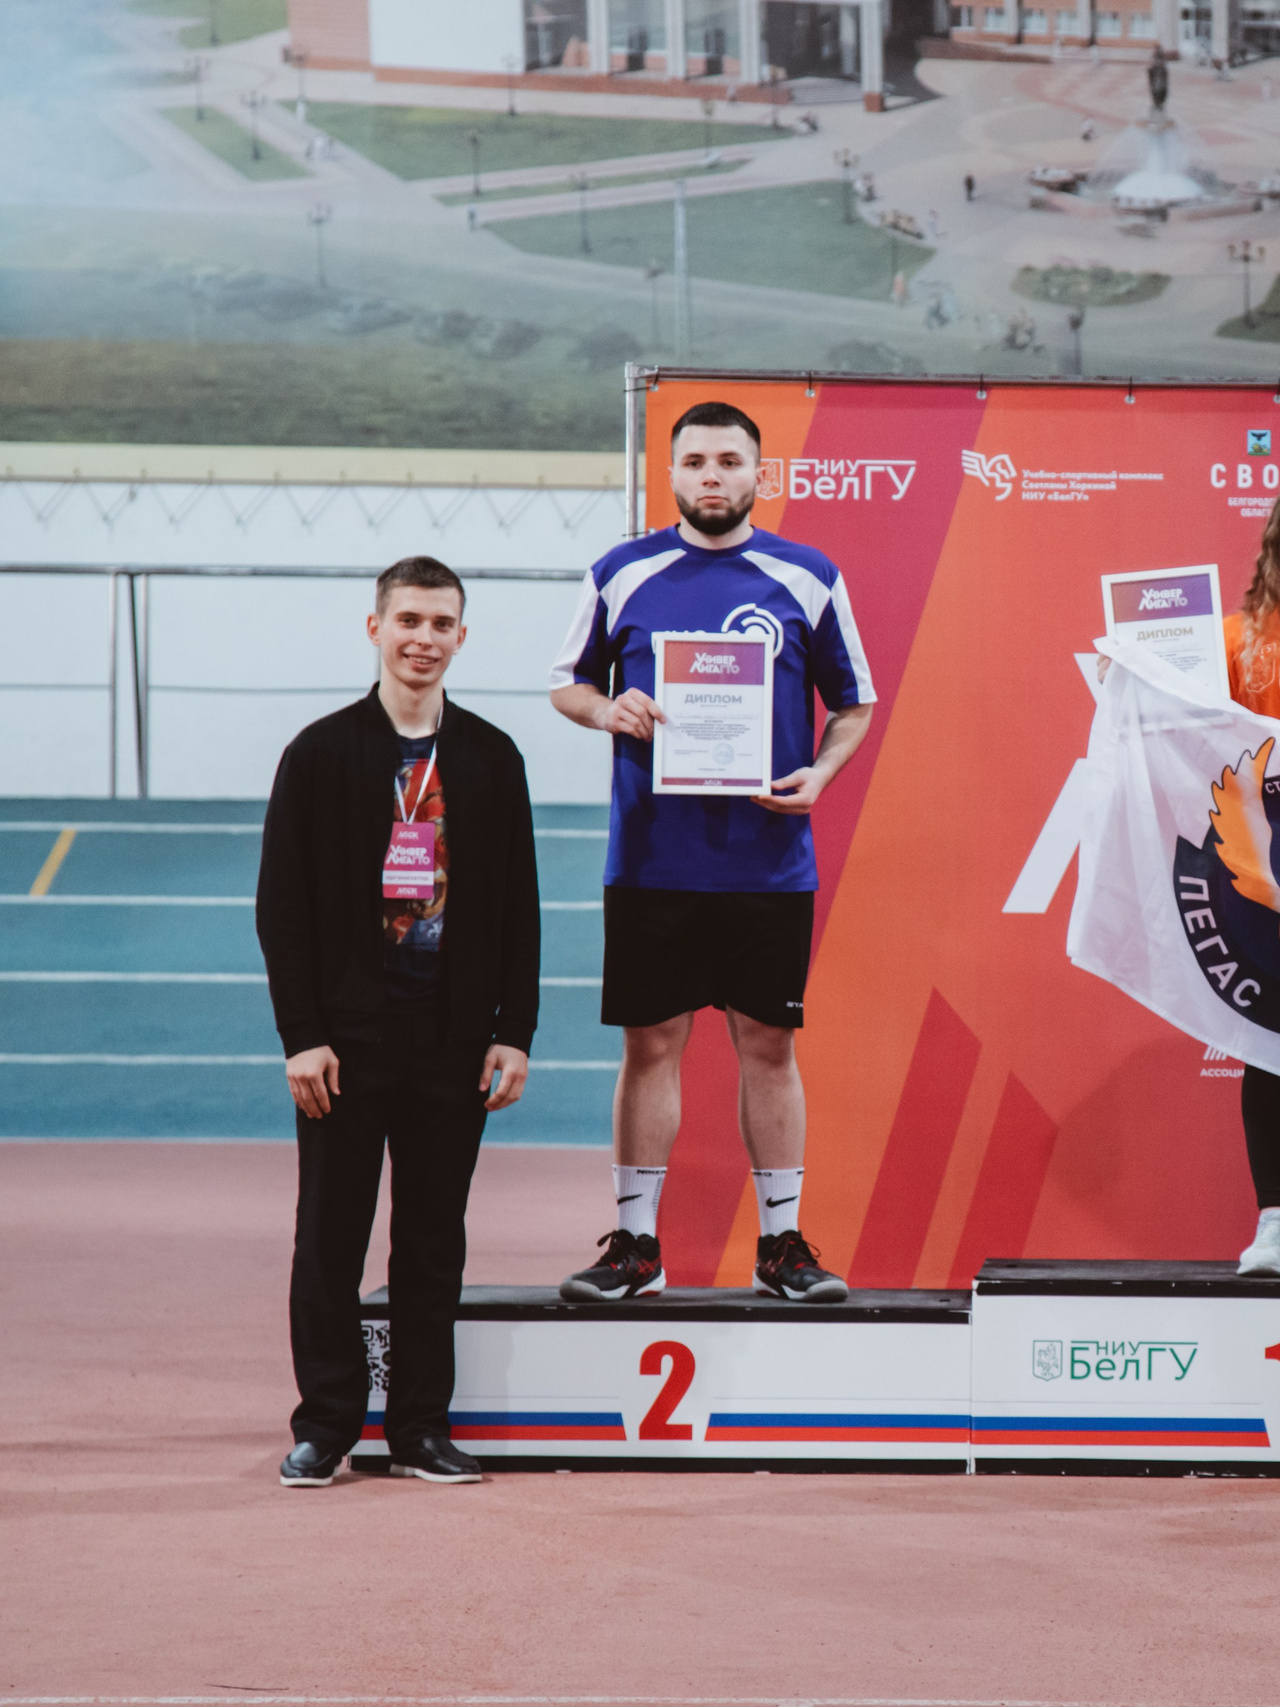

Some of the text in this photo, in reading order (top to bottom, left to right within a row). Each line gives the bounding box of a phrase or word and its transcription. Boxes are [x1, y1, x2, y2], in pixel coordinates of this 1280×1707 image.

[815, 459, 860, 475] НИУ
[788, 464, 917, 500] БелГУ
[1021, 469, 1165, 481] Учебно-спортивный комплекс
[1021, 480, 1068, 490] Светланы
[1021, 491, 1046, 501] НИУ
[1136, 627, 1194, 641] ДИПЛОМ
[684, 693, 743, 705] ДИПЛОМ
[1179, 875, 1261, 1008] ПЕГАС
[1200, 1067, 1245, 1078] АССОЦИ
[1096, 1342, 1142, 1357] НИУ
[1069, 1347, 1198, 1382] БелГУ
[639, 1340, 697, 1441] 2
